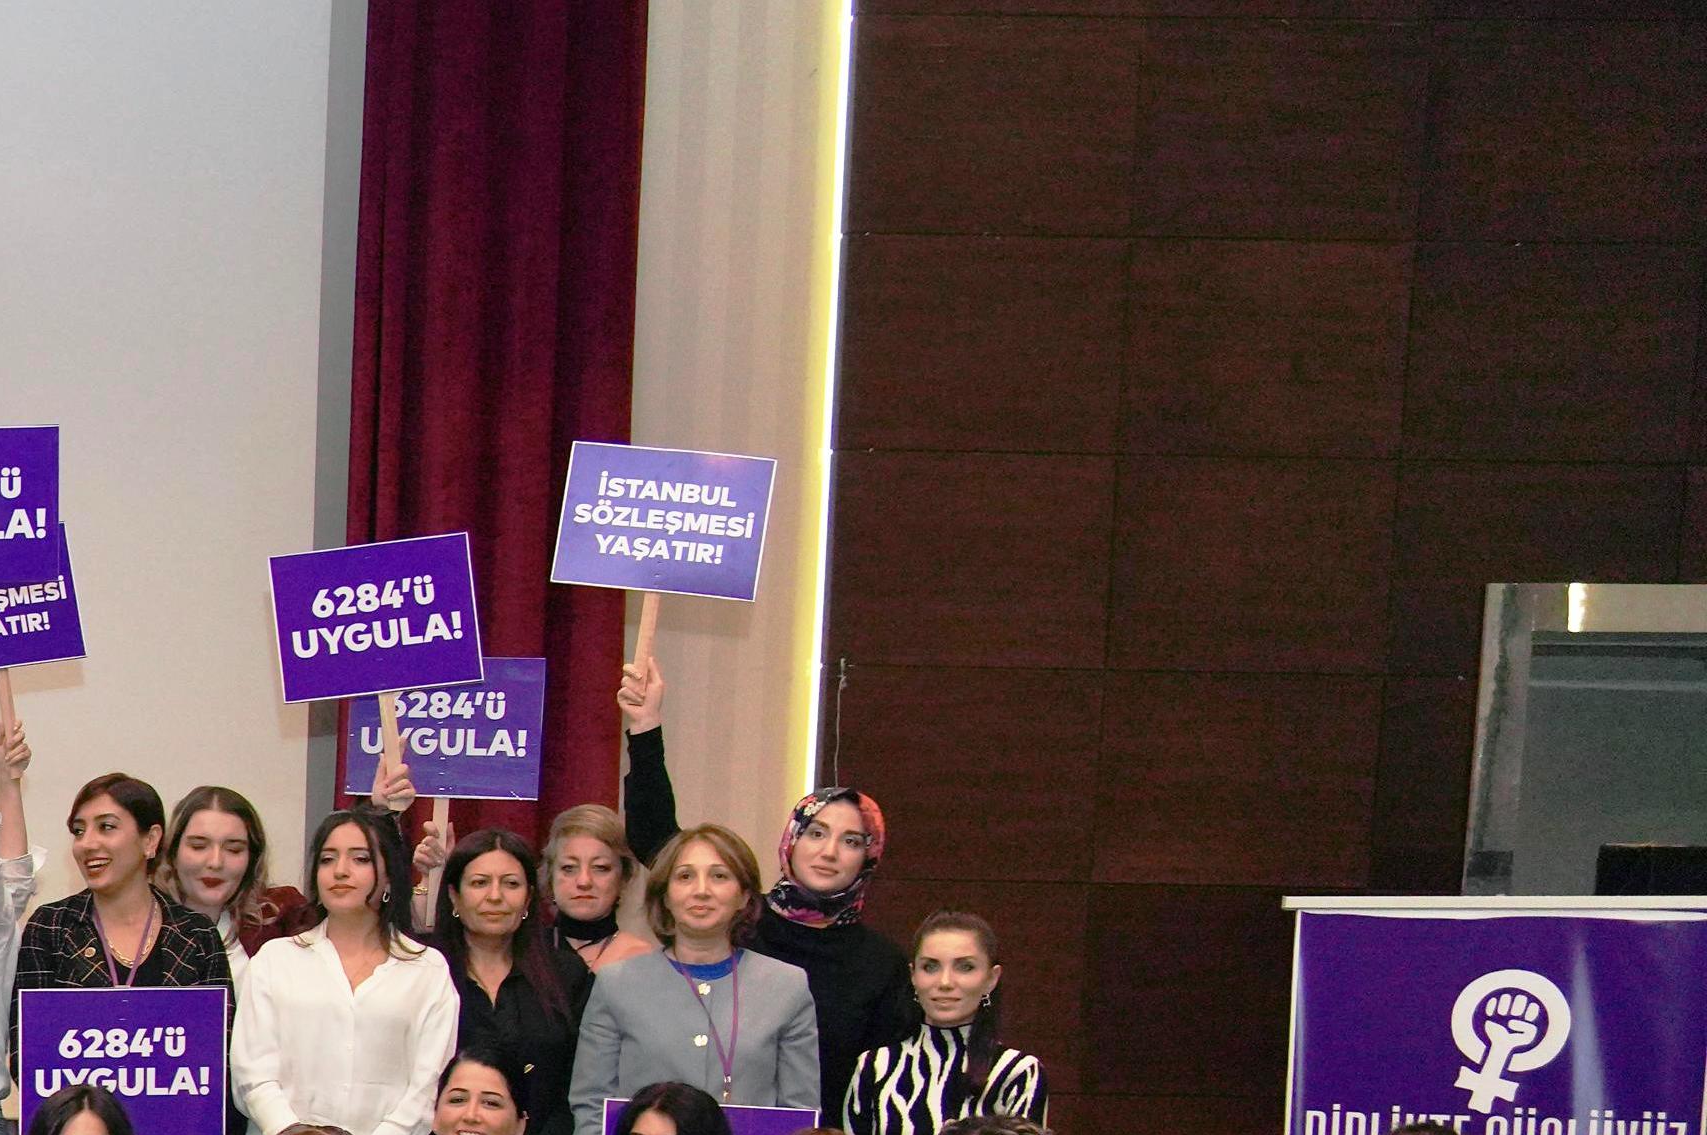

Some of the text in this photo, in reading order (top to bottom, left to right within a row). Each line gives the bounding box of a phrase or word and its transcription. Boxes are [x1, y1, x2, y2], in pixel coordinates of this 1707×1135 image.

[597, 470, 737, 508] İSTANBUL
[573, 498, 755, 539] SÖZLEŞMESİ
[594, 533, 724, 565] YAŞATIR!
[311, 574, 435, 619] 6284'Ü
[291, 610, 464, 659] UYGULA!
[58, 1026, 186, 1059] 6284'Ü
